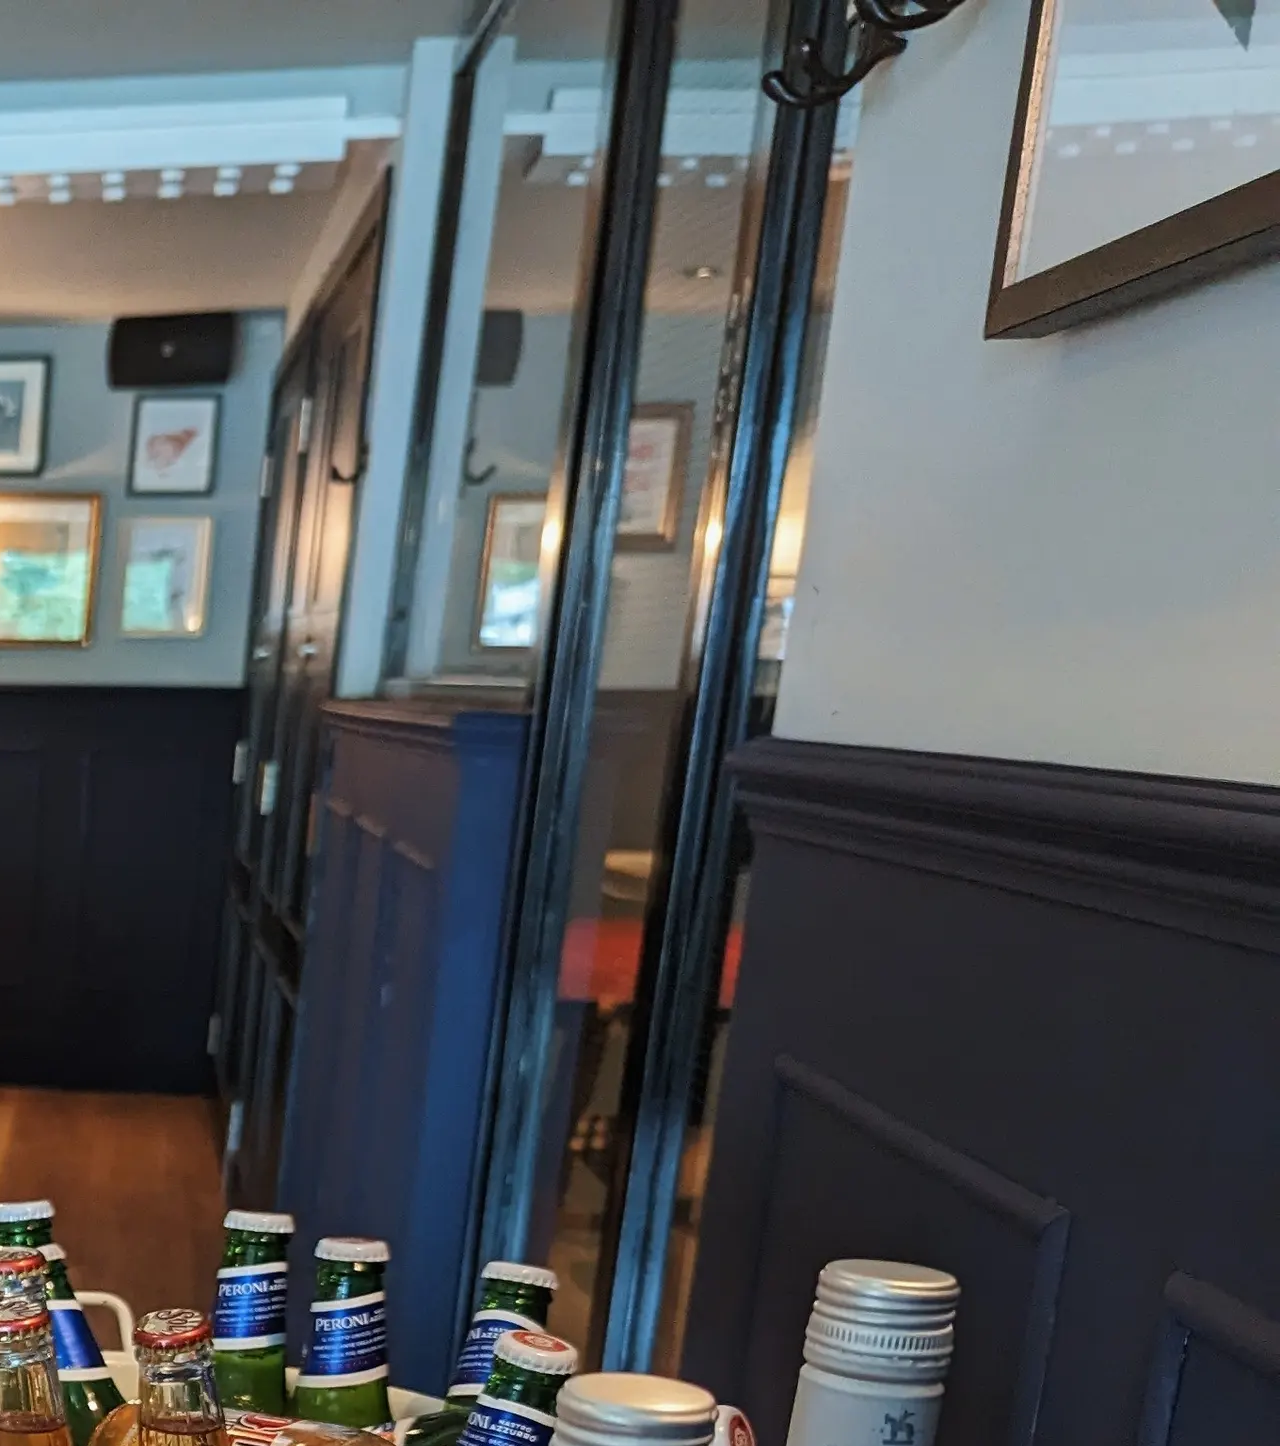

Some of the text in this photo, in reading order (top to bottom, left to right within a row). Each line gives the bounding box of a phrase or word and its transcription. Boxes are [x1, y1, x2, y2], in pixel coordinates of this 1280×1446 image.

[218, 1279, 270, 1297] PERONI
[314, 1311, 371, 1332] PERONI
[488, 1423, 538, 1443] AZZURRO
[498, 1419, 533, 1433] NASTRO
